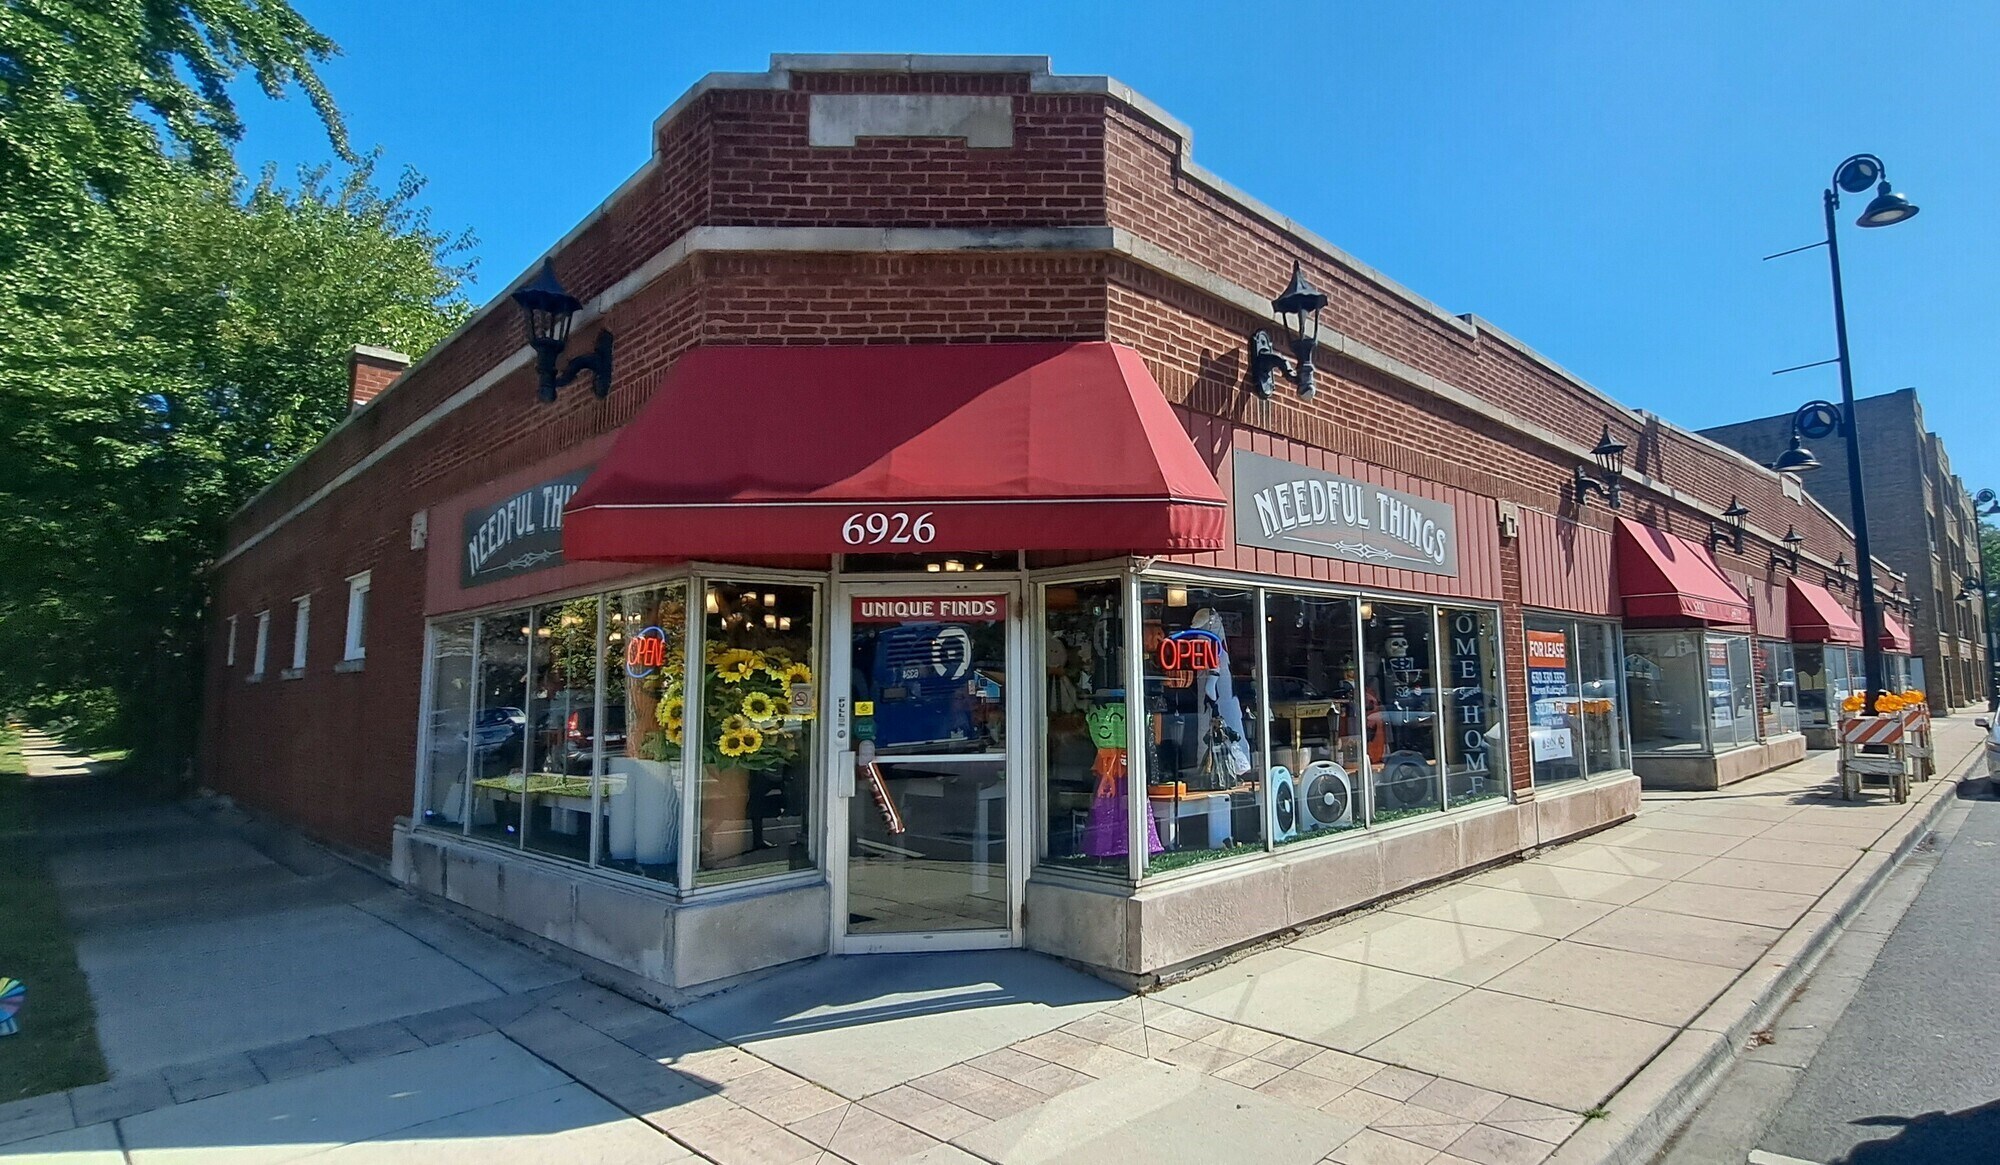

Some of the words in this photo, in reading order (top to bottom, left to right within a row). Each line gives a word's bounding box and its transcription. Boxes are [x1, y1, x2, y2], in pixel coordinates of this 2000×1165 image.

[468, 492, 535, 577] NEEDFUL
[842, 512, 936, 545] 6926
[1253, 479, 1370, 539] NEEDFUL
[1375, 491, 1446, 565] THINGS
[861, 601, 935, 617] UNIQUE
[940, 600, 997, 617] FINDS
[628, 637, 664, 666] OPEN
[1160, 638, 1219, 670] OPEN
[1530, 640, 1544, 657] FOR
[1544, 641, 1566, 659] LEASE
[1462, 705, 1489, 795] HOME
